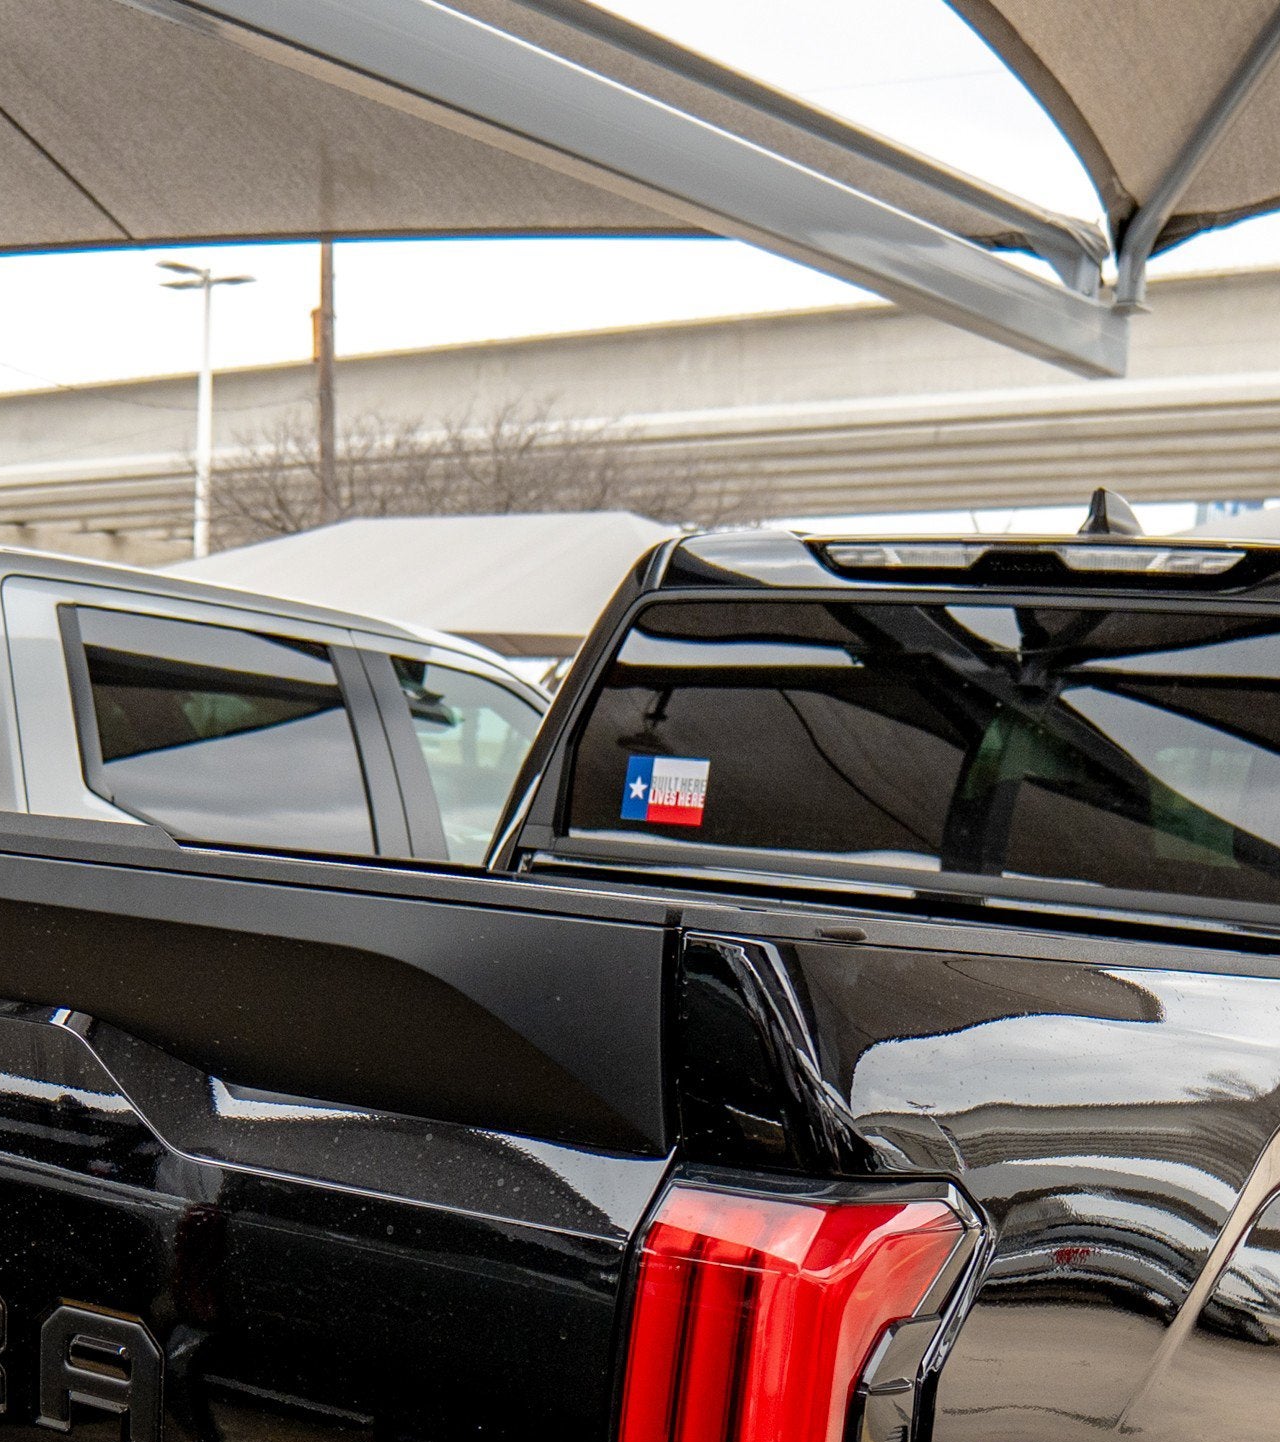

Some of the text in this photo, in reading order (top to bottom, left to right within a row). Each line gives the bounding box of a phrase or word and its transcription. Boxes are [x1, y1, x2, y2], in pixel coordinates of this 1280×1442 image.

[651, 776, 707, 792] BUILT HERE
[649, 790, 705, 808] LIVES HERE
